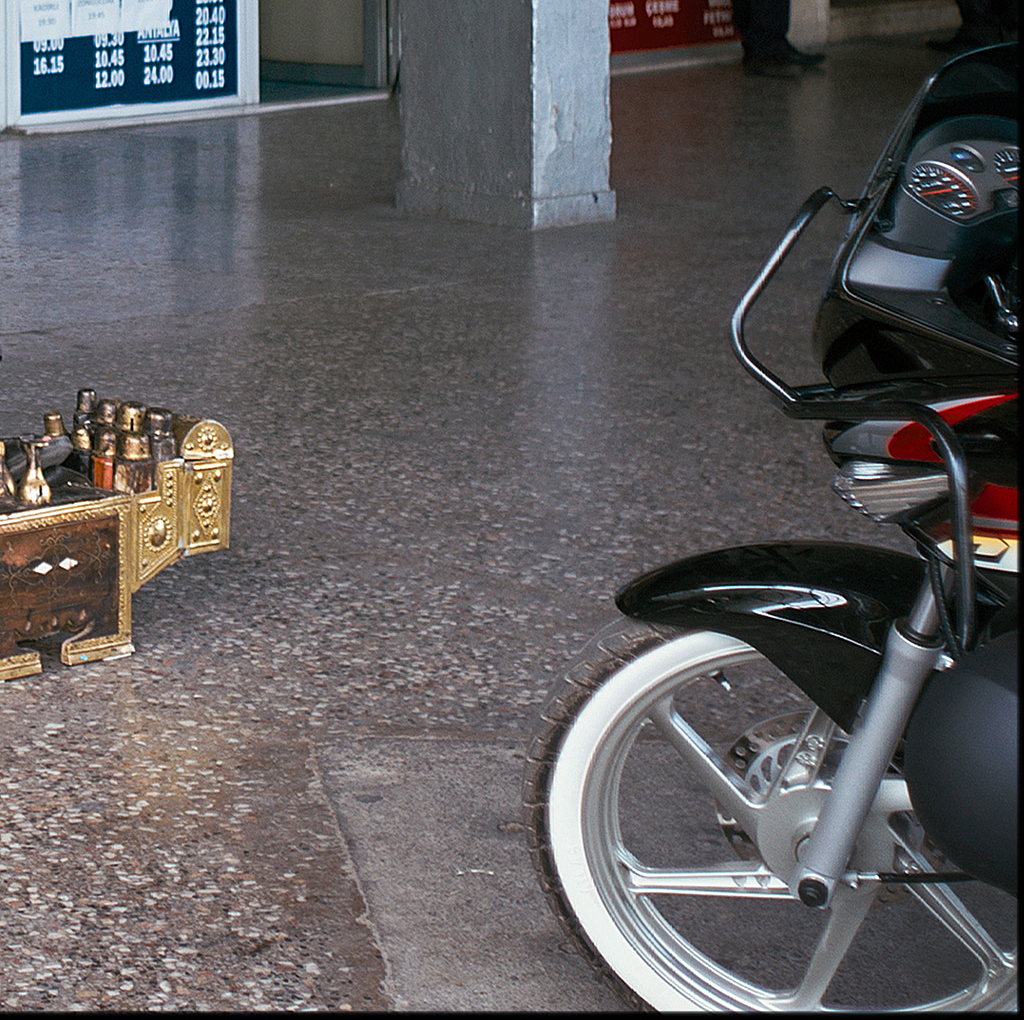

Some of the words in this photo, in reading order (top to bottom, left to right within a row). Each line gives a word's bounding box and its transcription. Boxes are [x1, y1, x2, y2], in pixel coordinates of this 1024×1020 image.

[195, 5, 226, 26] 20.40
[195, 26, 226, 47] 22.15
[95, 49, 125, 69] 10.45
[143, 43, 173, 64] 10.45
[195, 46, 226, 68] 23.30
[33, 55, 65, 75] 16.15
[143, 65, 174, 85] 24.00
[95, 69, 125, 89] 12.00
[195, 69, 226, 90] 00.15
